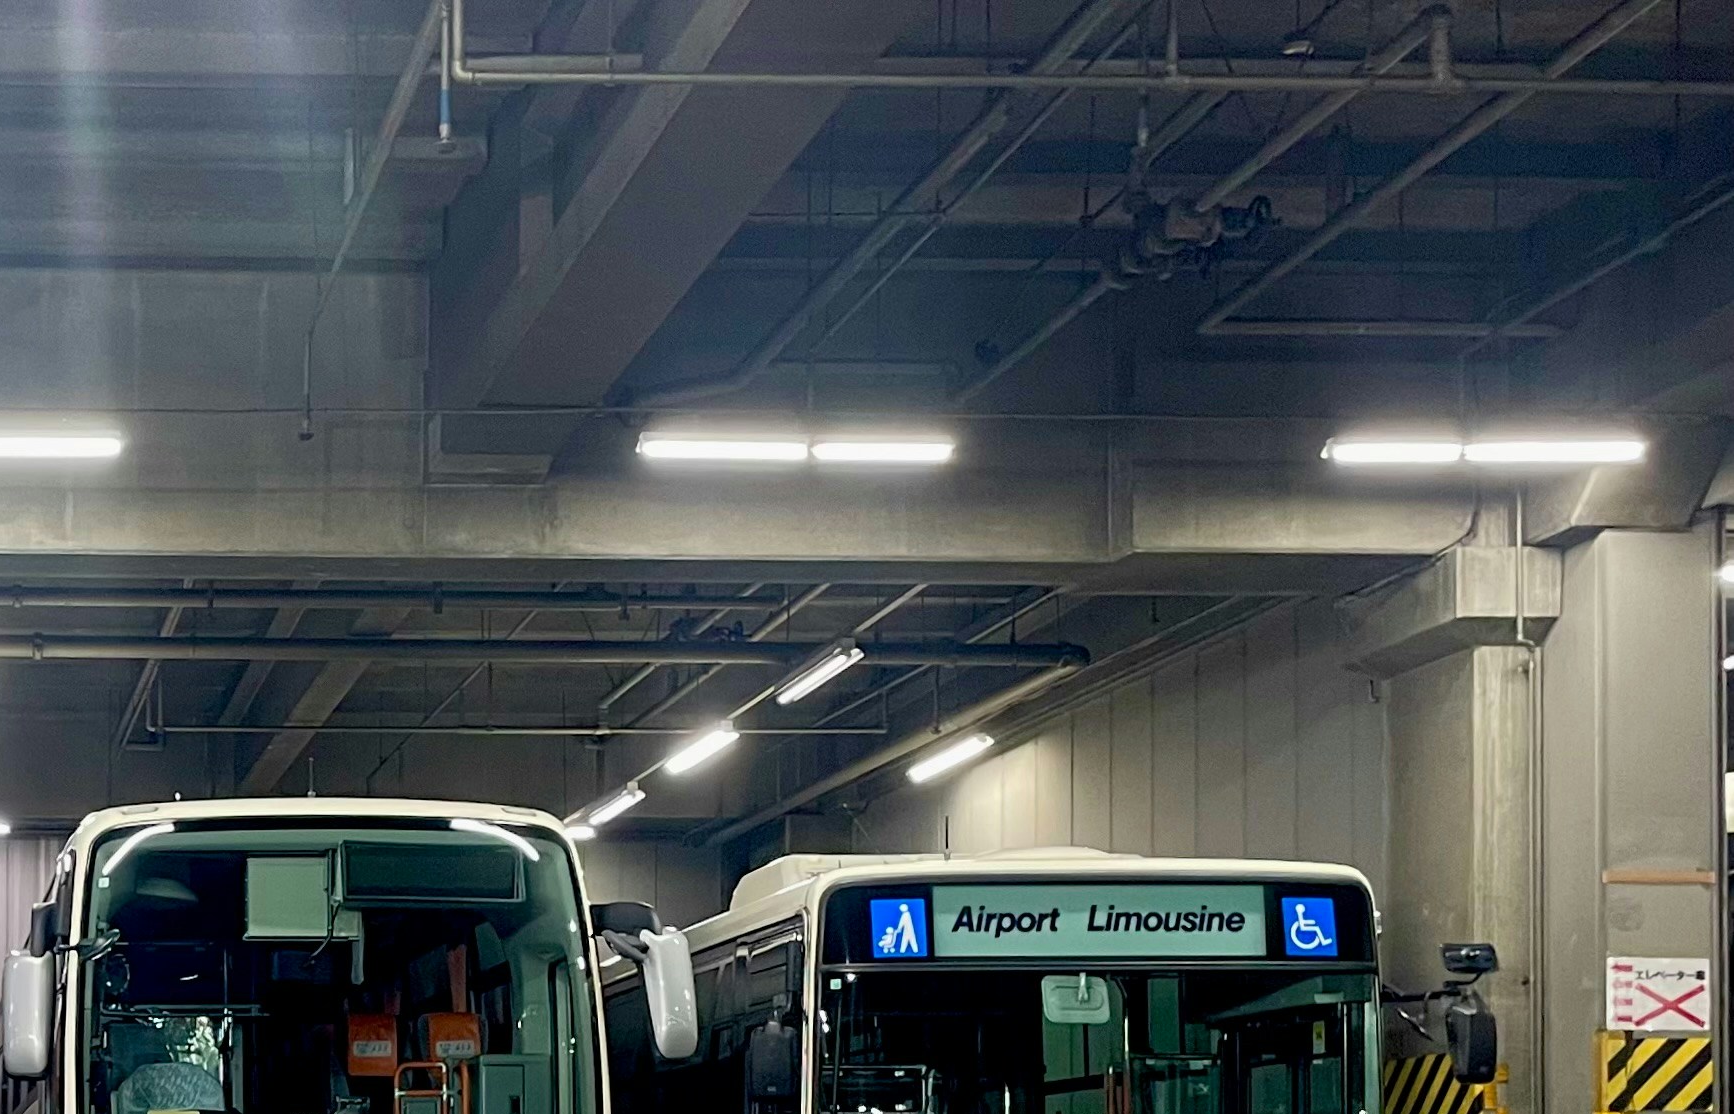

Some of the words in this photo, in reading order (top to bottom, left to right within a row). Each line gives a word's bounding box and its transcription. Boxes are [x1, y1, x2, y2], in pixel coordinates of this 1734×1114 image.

[951, 905, 1061, 938] Airport
[1087, 904, 1246, 932] Limousine
[1634, 970, 1706, 982] エレベーター
